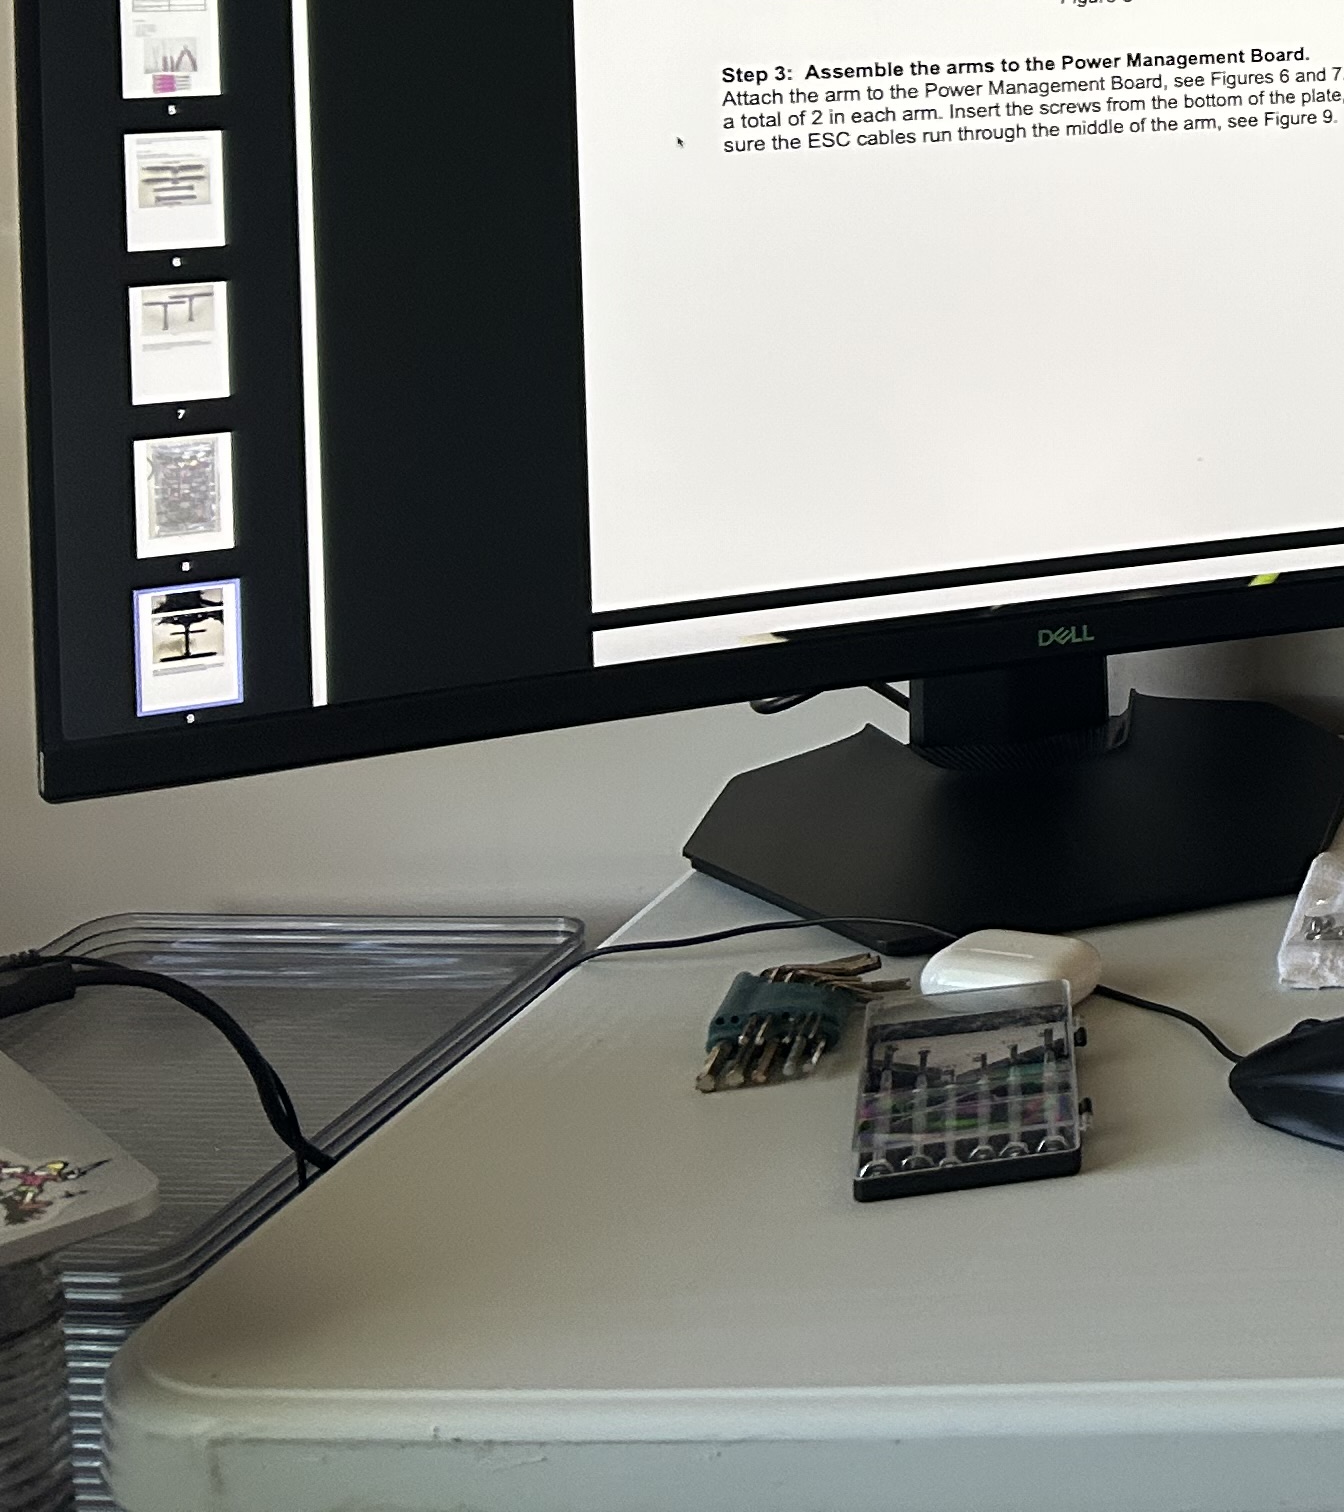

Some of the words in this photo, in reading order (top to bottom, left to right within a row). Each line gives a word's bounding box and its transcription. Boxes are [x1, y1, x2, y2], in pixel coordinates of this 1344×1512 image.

[722, 68, 768, 85] Step
[775, 66, 792, 81] 3:
[805, 62, 903, 80] Assemble
[910, 61, 940, 76] the
[947, 62, 995, 74] arms
[1001, 59, 1020, 72] to
[1025, 57, 1055, 71] the
[1062, 56, 1121, 70] Power
[1127, 51, 1245, 69] Management
[1251, 47, 1309, 62] Board.
[722, 89, 783, 106] Attach
[789, 88, 818, 104] the
[825, 90, 860, 102] arm
[867, 86, 883, 100] to
[890, 84, 919, 99] the
[925, 83, 983, 97] Power
[989, 77, 1105, 97] Management
[1111, 74, 1167, 90] Board,
[1174, 76, 1204, 87] see
[1211, 71, 1273, 89] Figures
[1280, 69, 1289, 83] 6
[1296, 67, 1326, 82] and
[723, 117, 735, 129] a
[741, 112, 781, 128] total
[788, 110, 807, 126] of
[812, 110, 823, 125] 2
[829, 109, 844, 124] in
[851, 107, 896, 123] each
[903, 109, 943, 121] arm.
[950, 103, 1001, 119] Insert
[1005, 102, 1033, 116] the
[1040, 102, 1101, 114] screws
[1106, 97, 1145, 112] from
[1152, 95, 1177, 109] the
[1184, 94, 1242, 108] bottom
[1248, 91, 1265, 105] of
[1269, 90, 1295, 104] the
[724, 139, 765, 152] sure
[771, 135, 801, 150] the
[808, 132, 850, 148] ESC
[857, 129, 916, 146] cables
[923, 131, 952, 142] run
[958, 124, 1026, 142] through
[1032, 123, 1059, 137] the
[1066, 119, 1124, 136] middle
[1130, 118, 1147, 132] of
[1151, 117, 1178, 131] the
[1184, 118, 1221, 131] arm,
[1228, 117, 1258, 128] see
[1265, 112, 1317, 129] Figure
[1323, 109, 1337, 123] 9.
[177, 409, 185, 419] 7
[1038, 625, 1095, 647] DELL
